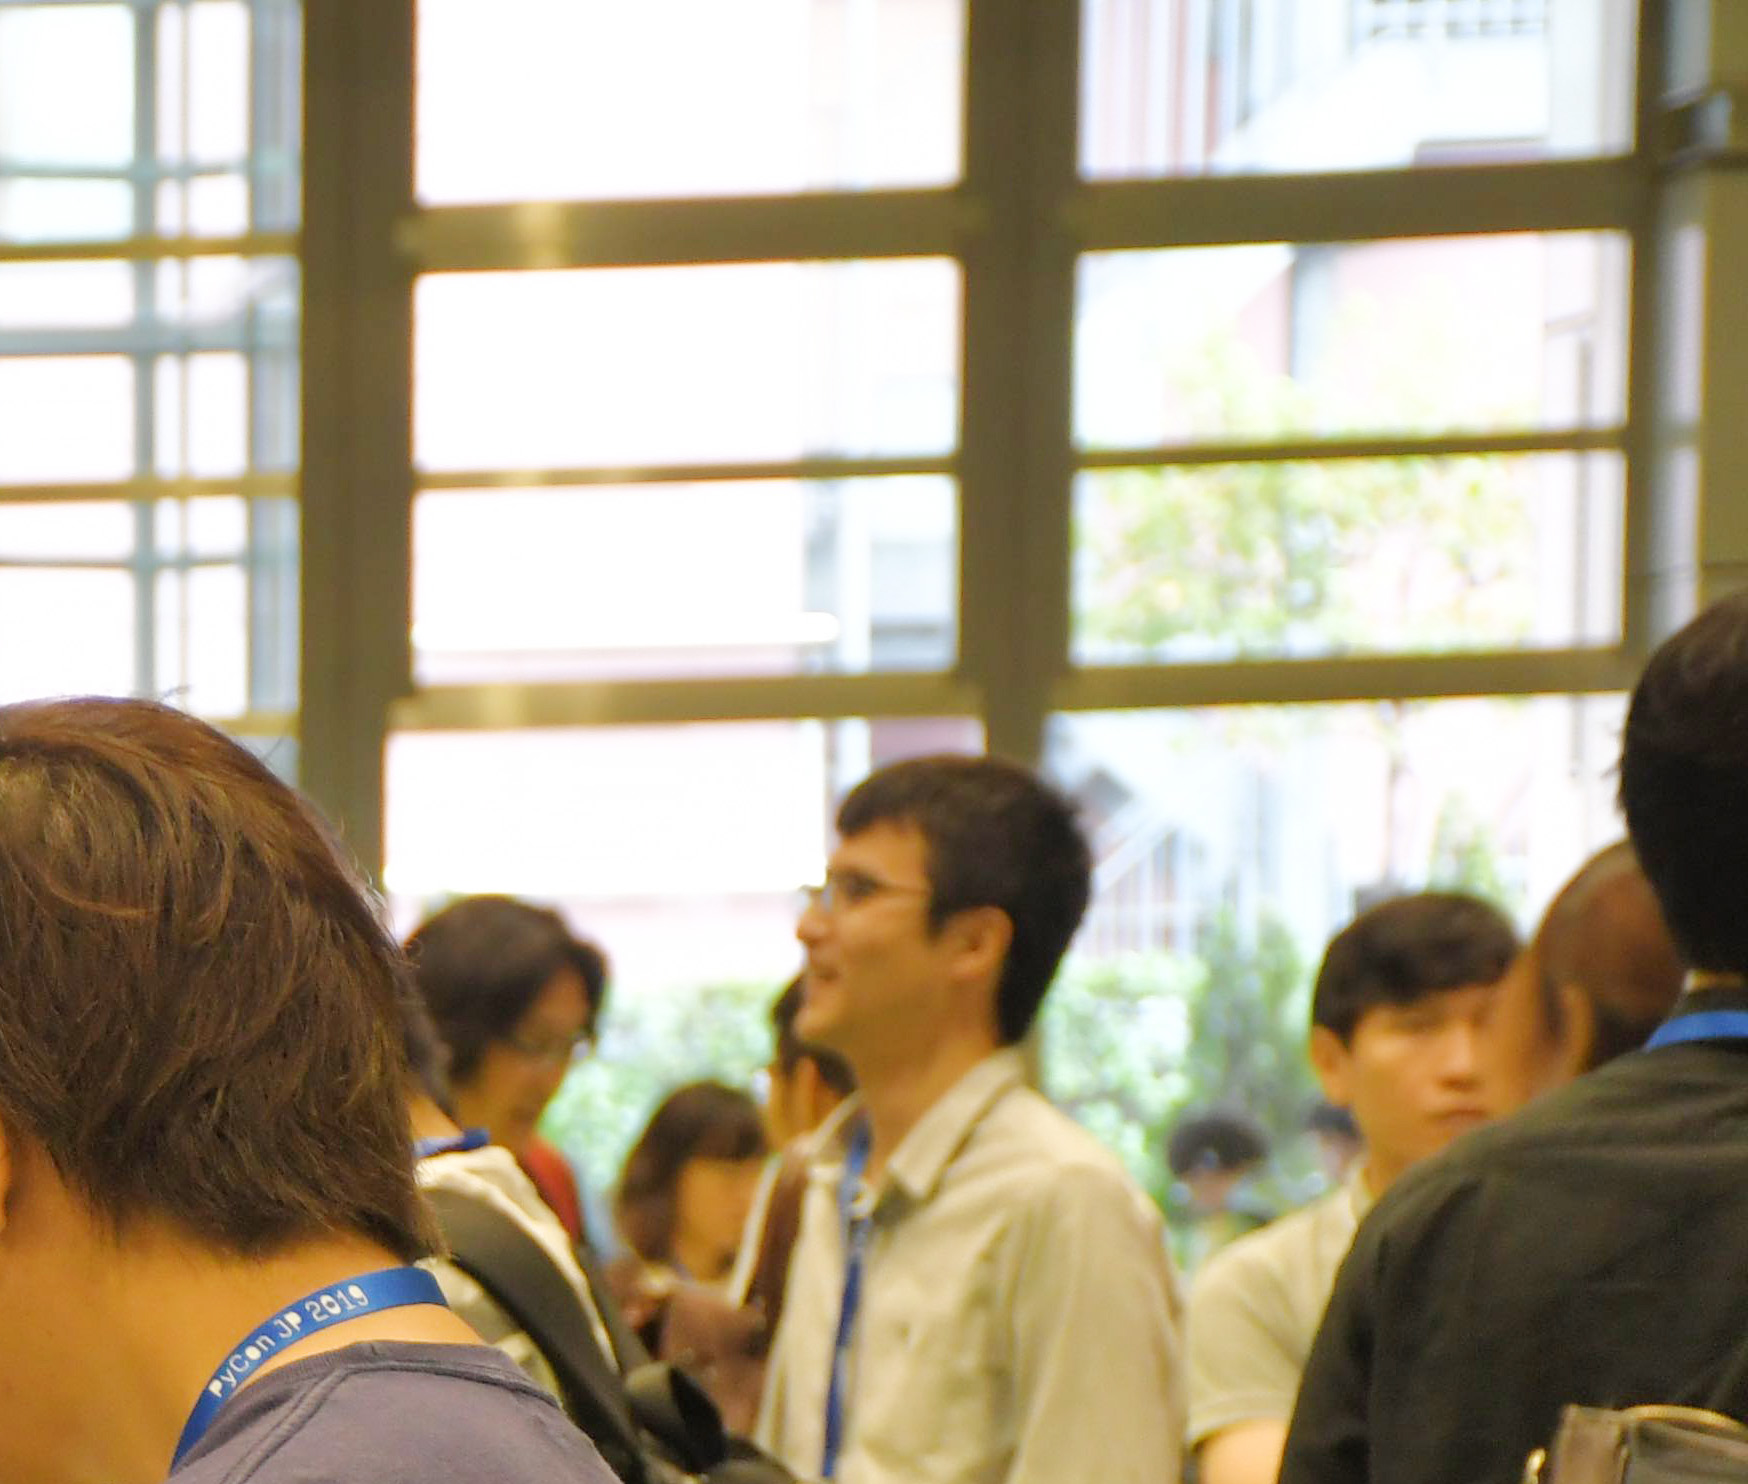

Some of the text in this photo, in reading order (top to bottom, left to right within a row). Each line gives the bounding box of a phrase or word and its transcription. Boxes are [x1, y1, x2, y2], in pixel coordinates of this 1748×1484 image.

[209, 1285, 369, 1397] PyCon JP 2019
